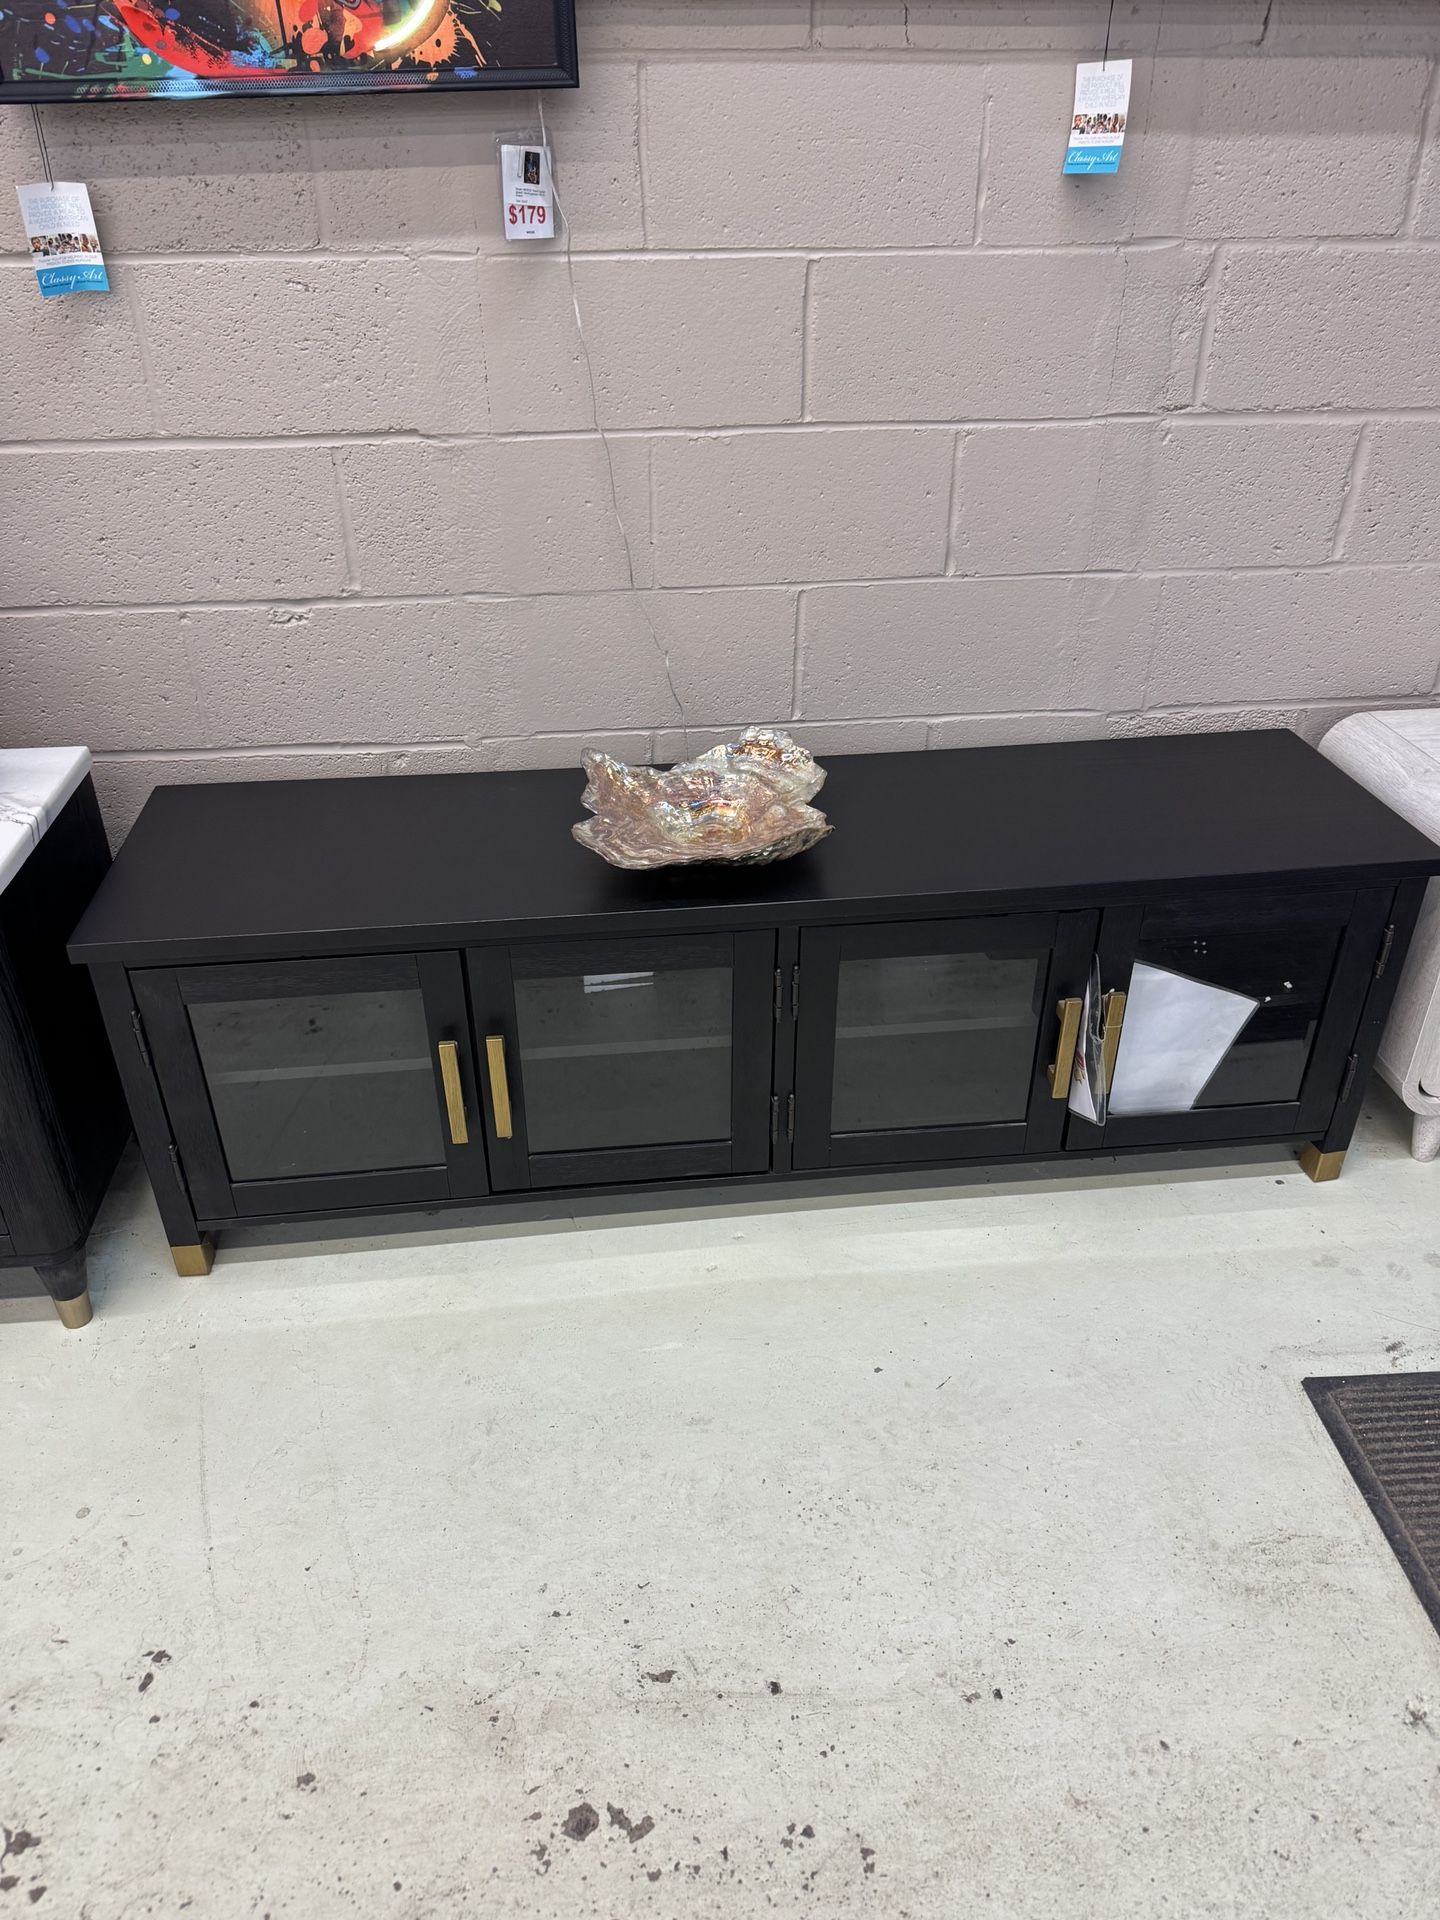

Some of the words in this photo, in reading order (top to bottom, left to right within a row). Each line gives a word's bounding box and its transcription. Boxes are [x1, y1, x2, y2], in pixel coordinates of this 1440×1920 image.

[1068, 150, 1097, 170] Classy
[1097, 150, 1118, 161] Art
[509, 204, 546, 225] $179
[42, 272, 76, 290] Classy
[80, 268, 103, 280] Art
